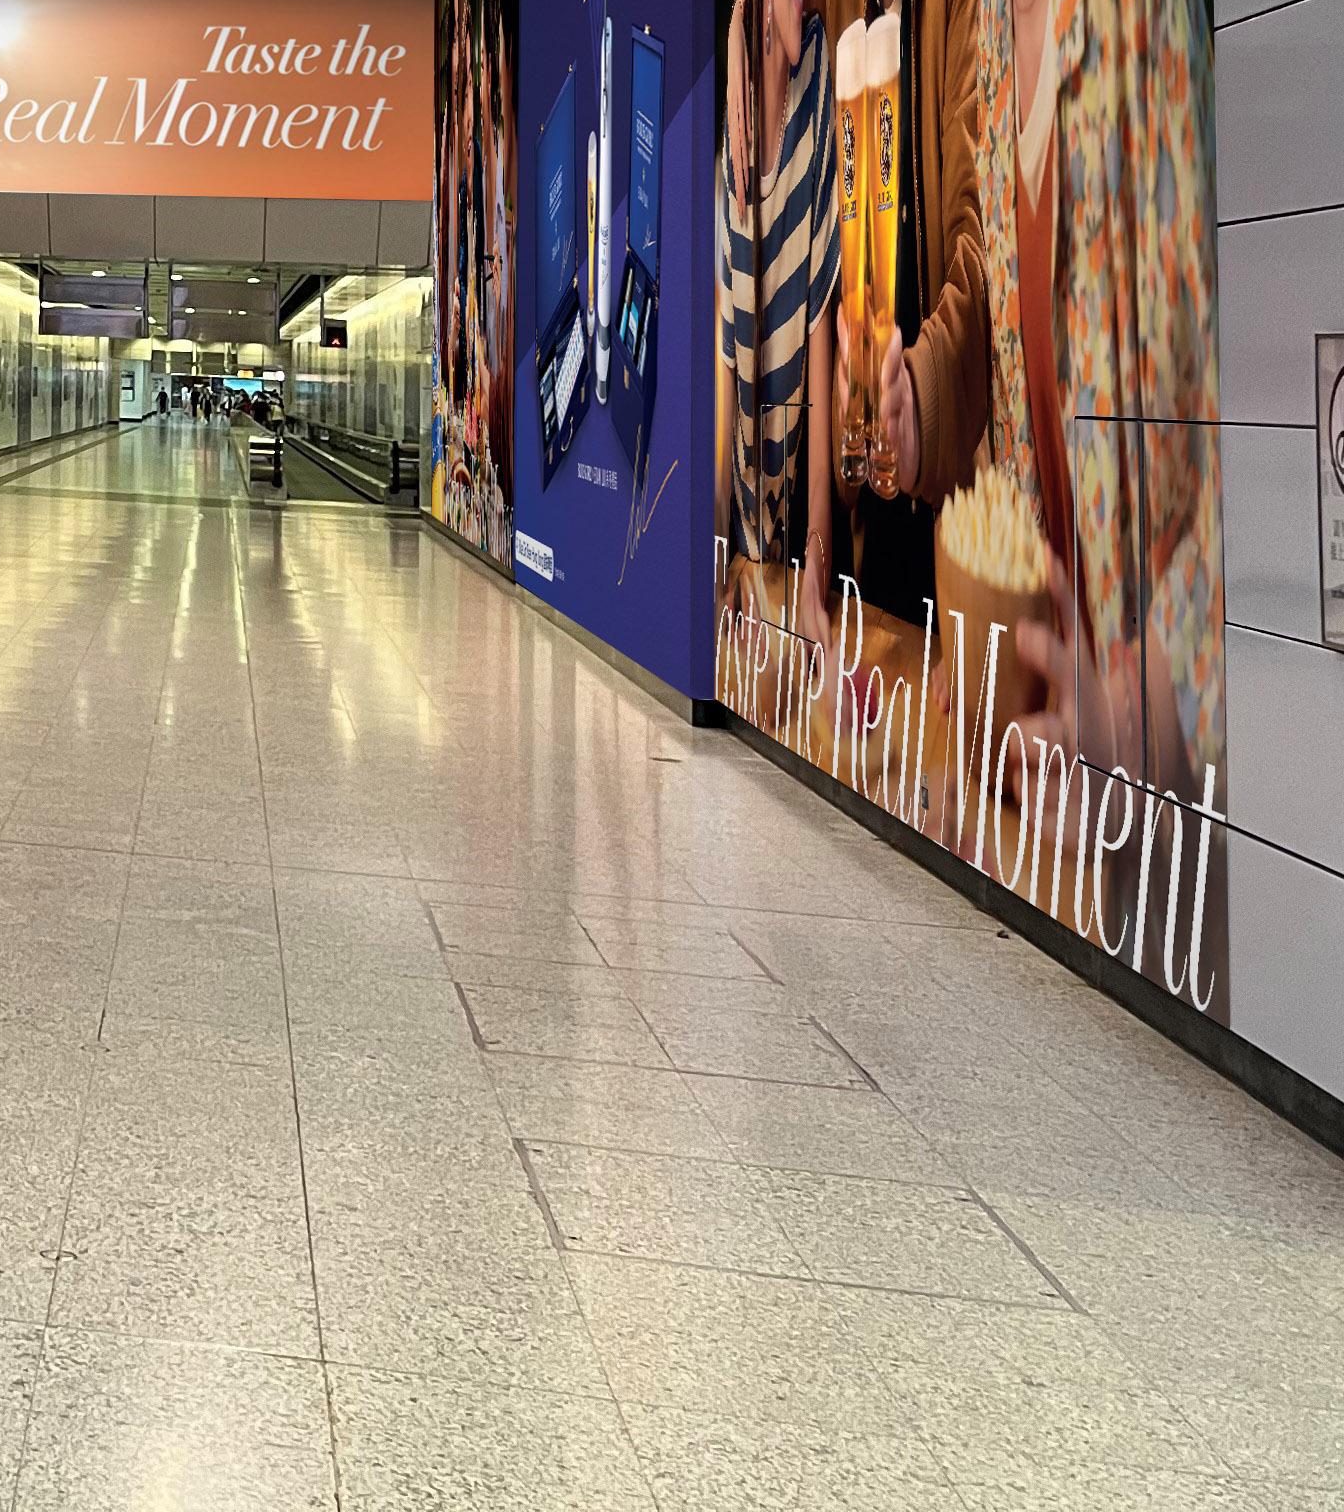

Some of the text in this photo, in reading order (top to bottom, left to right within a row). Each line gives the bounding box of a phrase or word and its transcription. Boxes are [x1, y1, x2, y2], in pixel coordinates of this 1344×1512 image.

[199, 23, 407, 77] Taste the
[104, 77, 394, 151] Moment
[831, 573, 936, 835] Real
[939, 609, 1227, 1013] Moment
